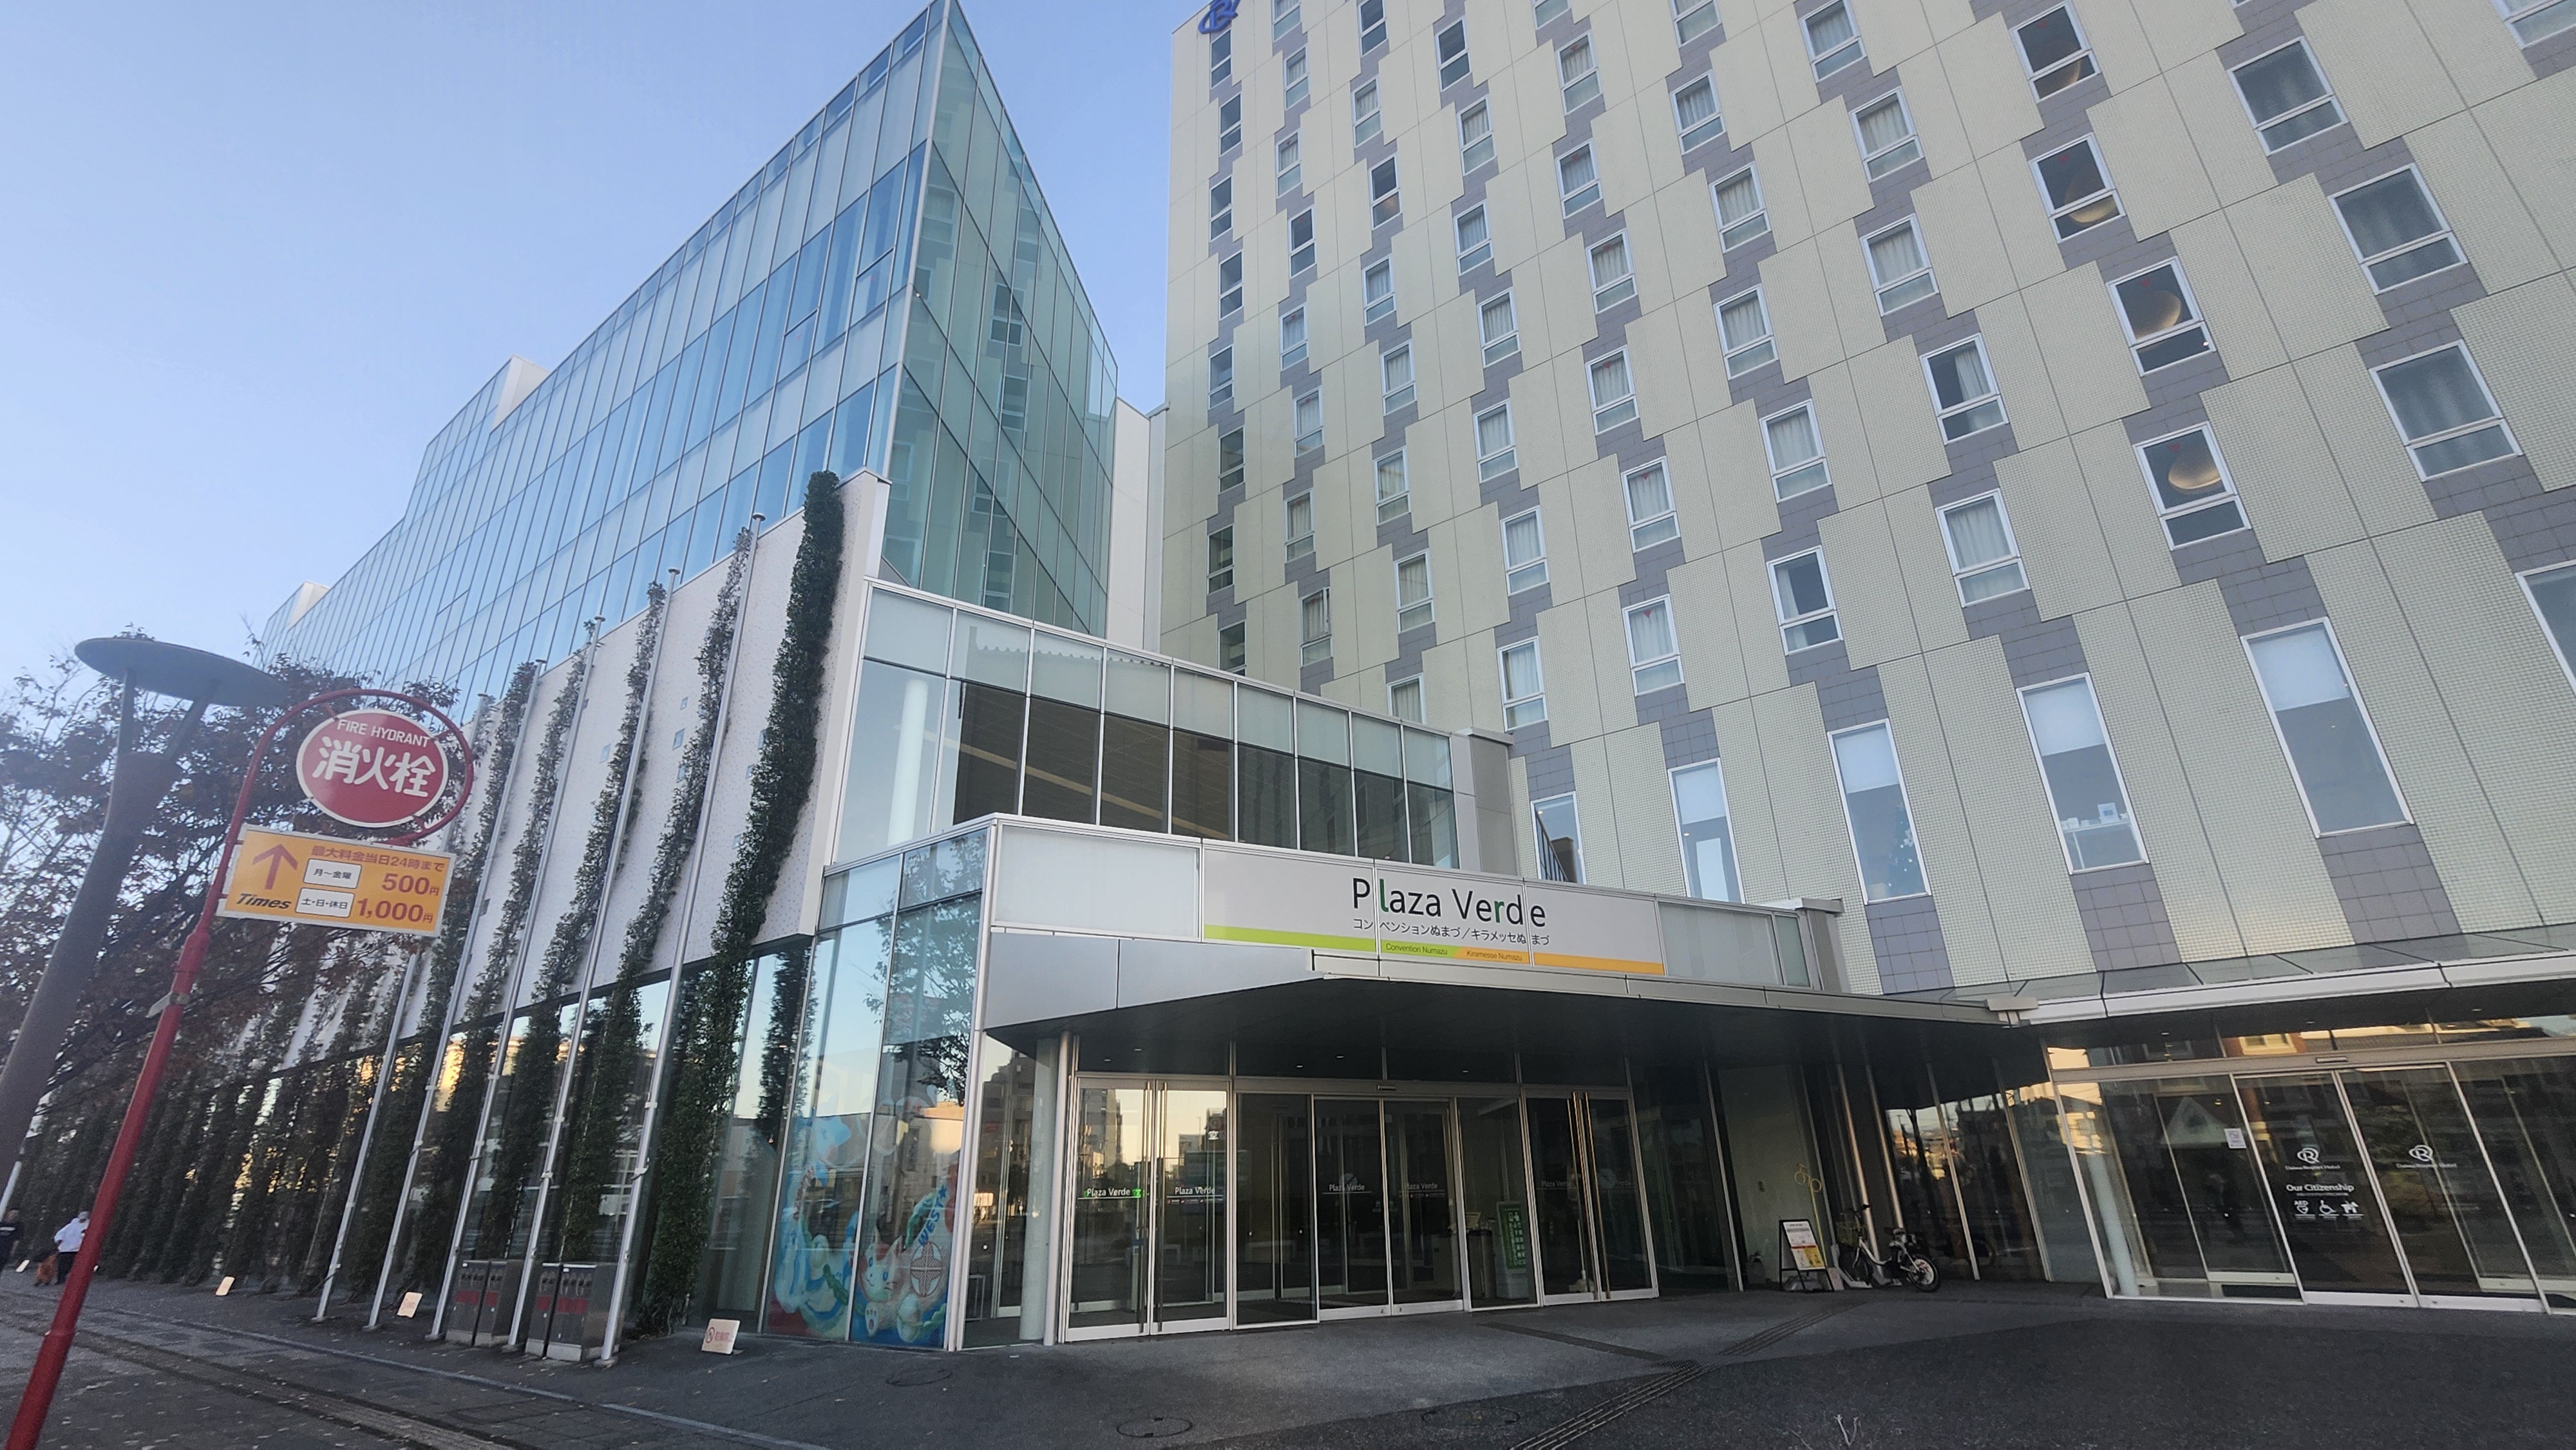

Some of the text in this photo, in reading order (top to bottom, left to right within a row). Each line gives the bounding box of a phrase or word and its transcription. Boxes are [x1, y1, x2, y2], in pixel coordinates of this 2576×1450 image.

[337, 719, 430, 748] FIRE HYDRANT
[312, 736, 436, 798] 消火栓
[311, 845, 445, 872] 最大料金当日24時まで
[381, 872, 440, 896] 500円
[236, 893, 292, 909] Times
[357, 898, 433, 923] 1,000円
[1353, 878, 1546, 927] Plaza Verde
[1386, 943, 1448, 955] Convention Numazu
[1467, 950, 1522, 961] Kiramesse Numazu
[1087, 1187, 1131, 1196] Plaza Verde
[1175, 1186, 1216, 1195] Plaza Verde
[2304, 1183, 2354, 1192] Citizenship
[918, 1196, 943, 1247] WEST
